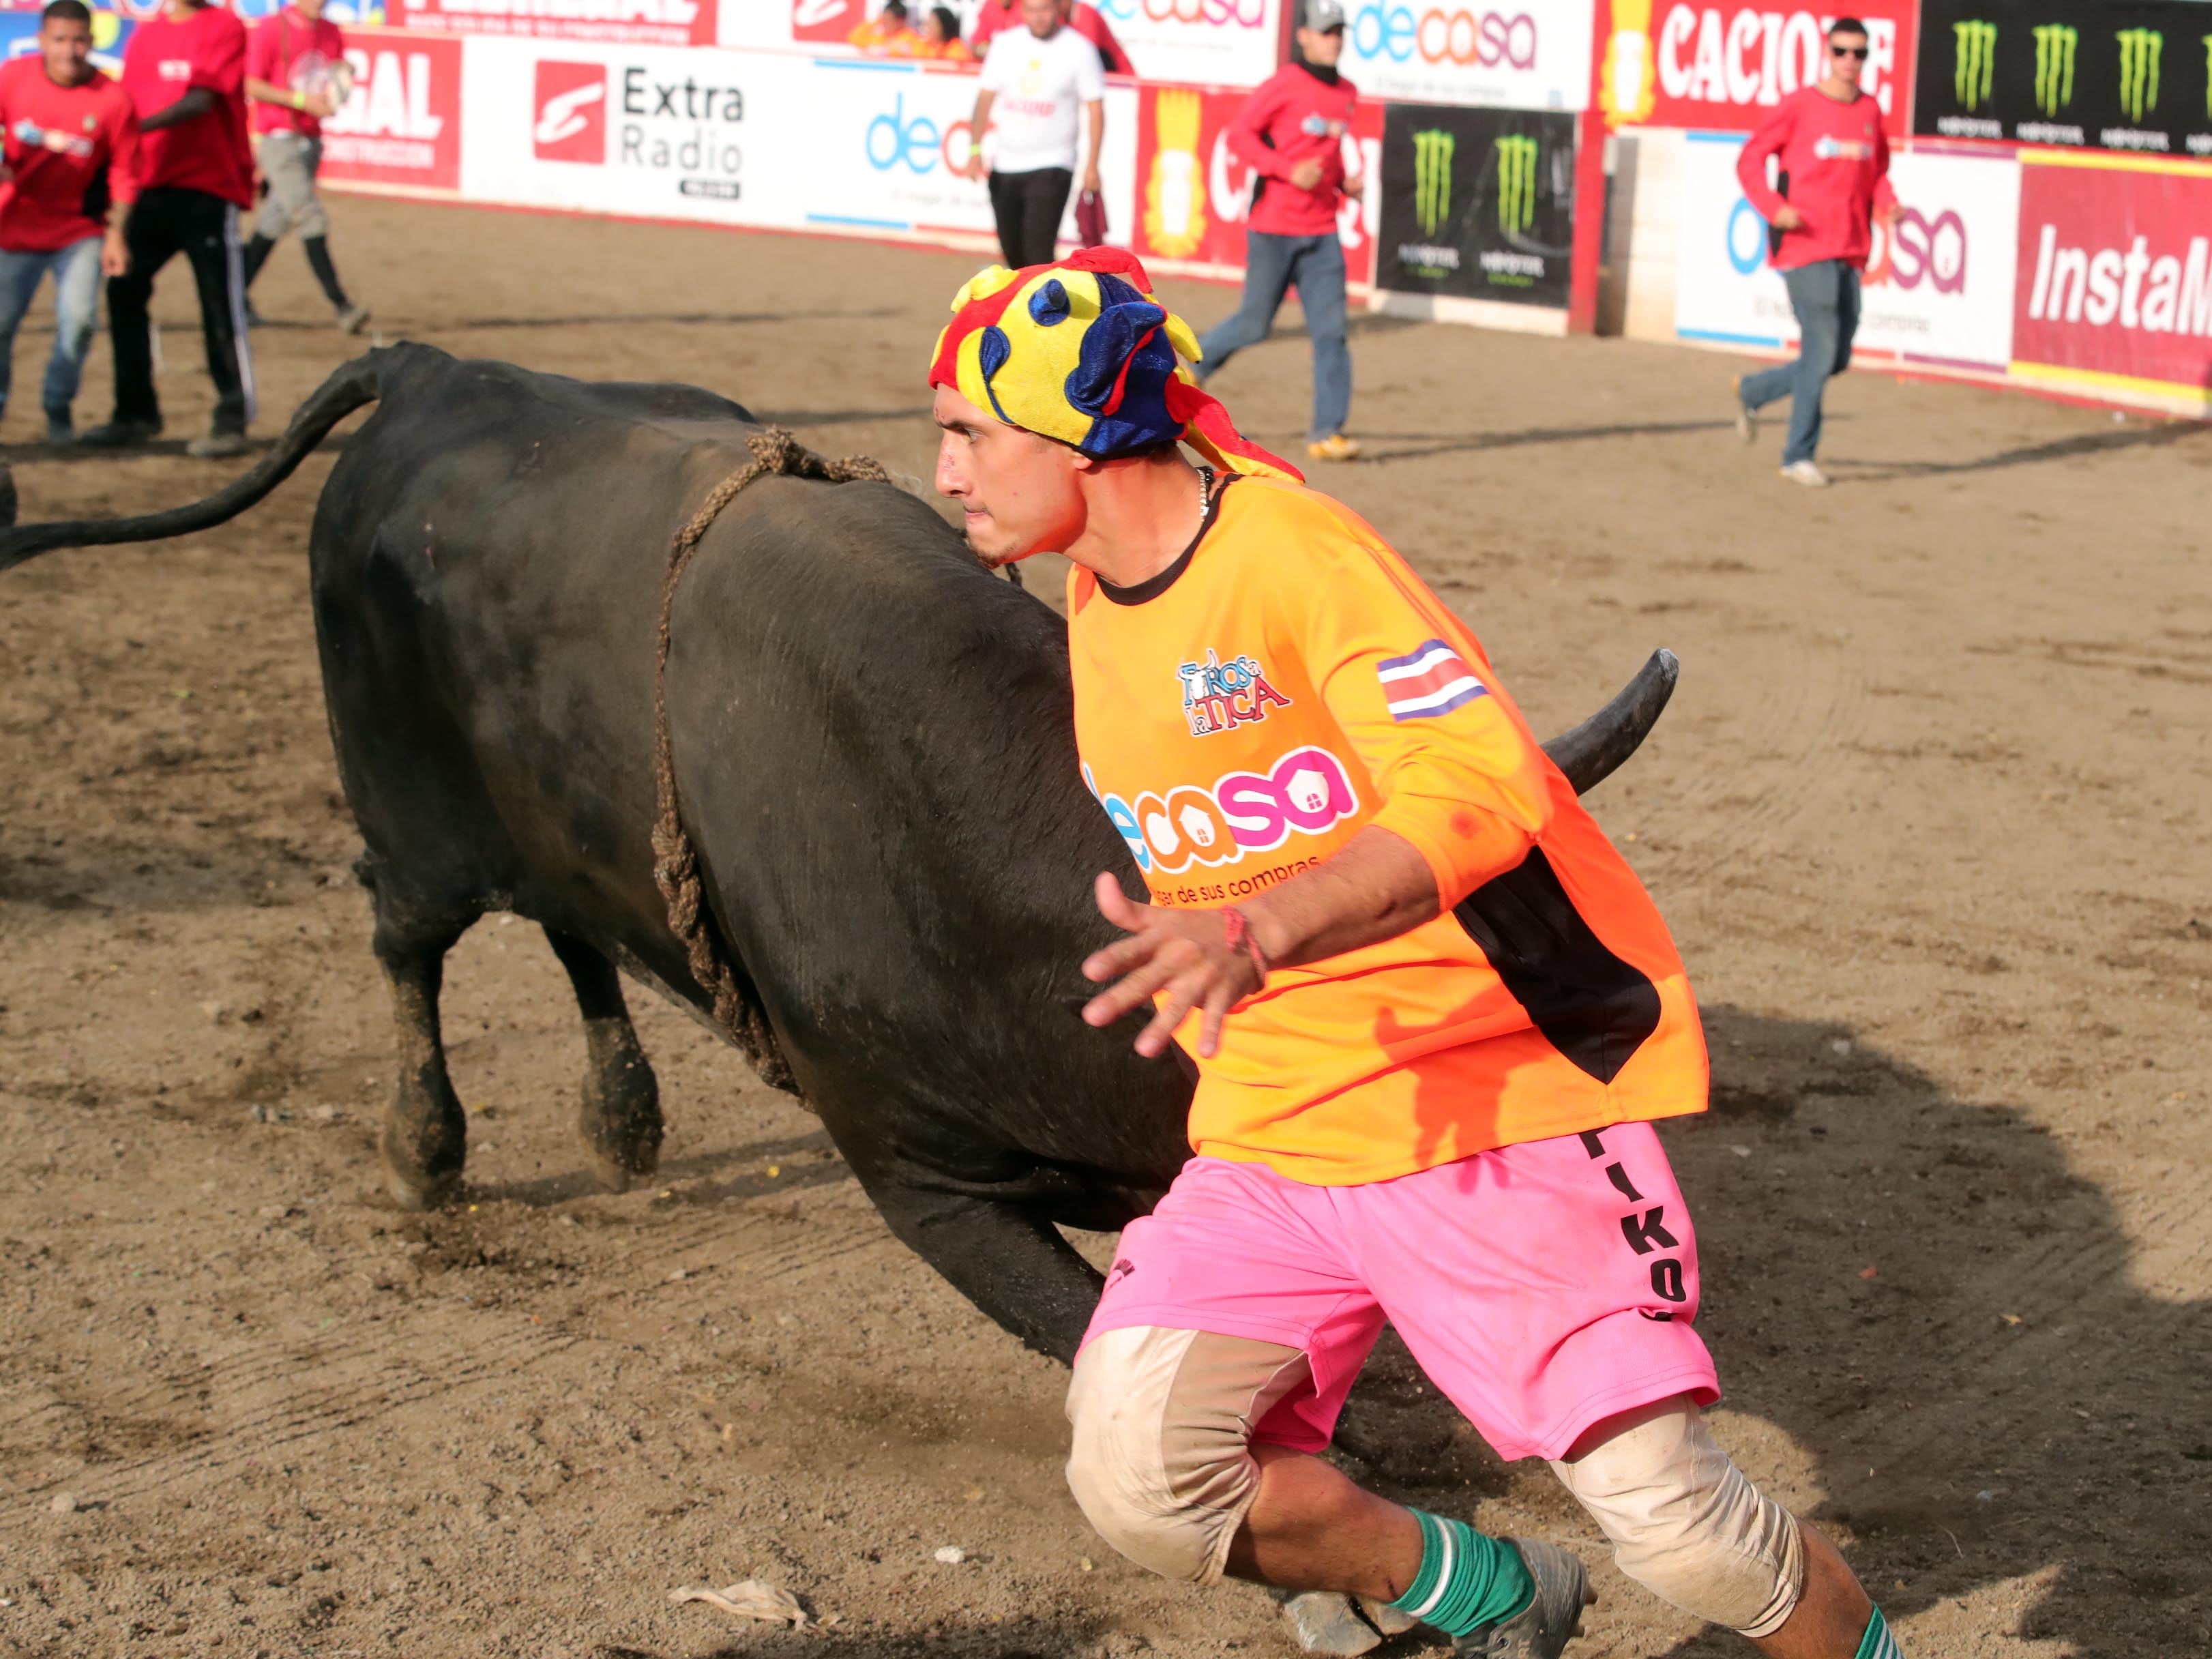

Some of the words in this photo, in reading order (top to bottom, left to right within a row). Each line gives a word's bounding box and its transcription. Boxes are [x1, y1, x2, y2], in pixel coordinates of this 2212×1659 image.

[623, 66, 743, 123] Extra
[621, 123, 743, 175] Radio
[1195, 676, 1291, 732] TICA
[1083, 748, 1357, 872] ecasa
[1177, 885, 1198, 903] de
[1199, 884, 1226, 901] sus
[1228, 855, 1321, 897] compras
